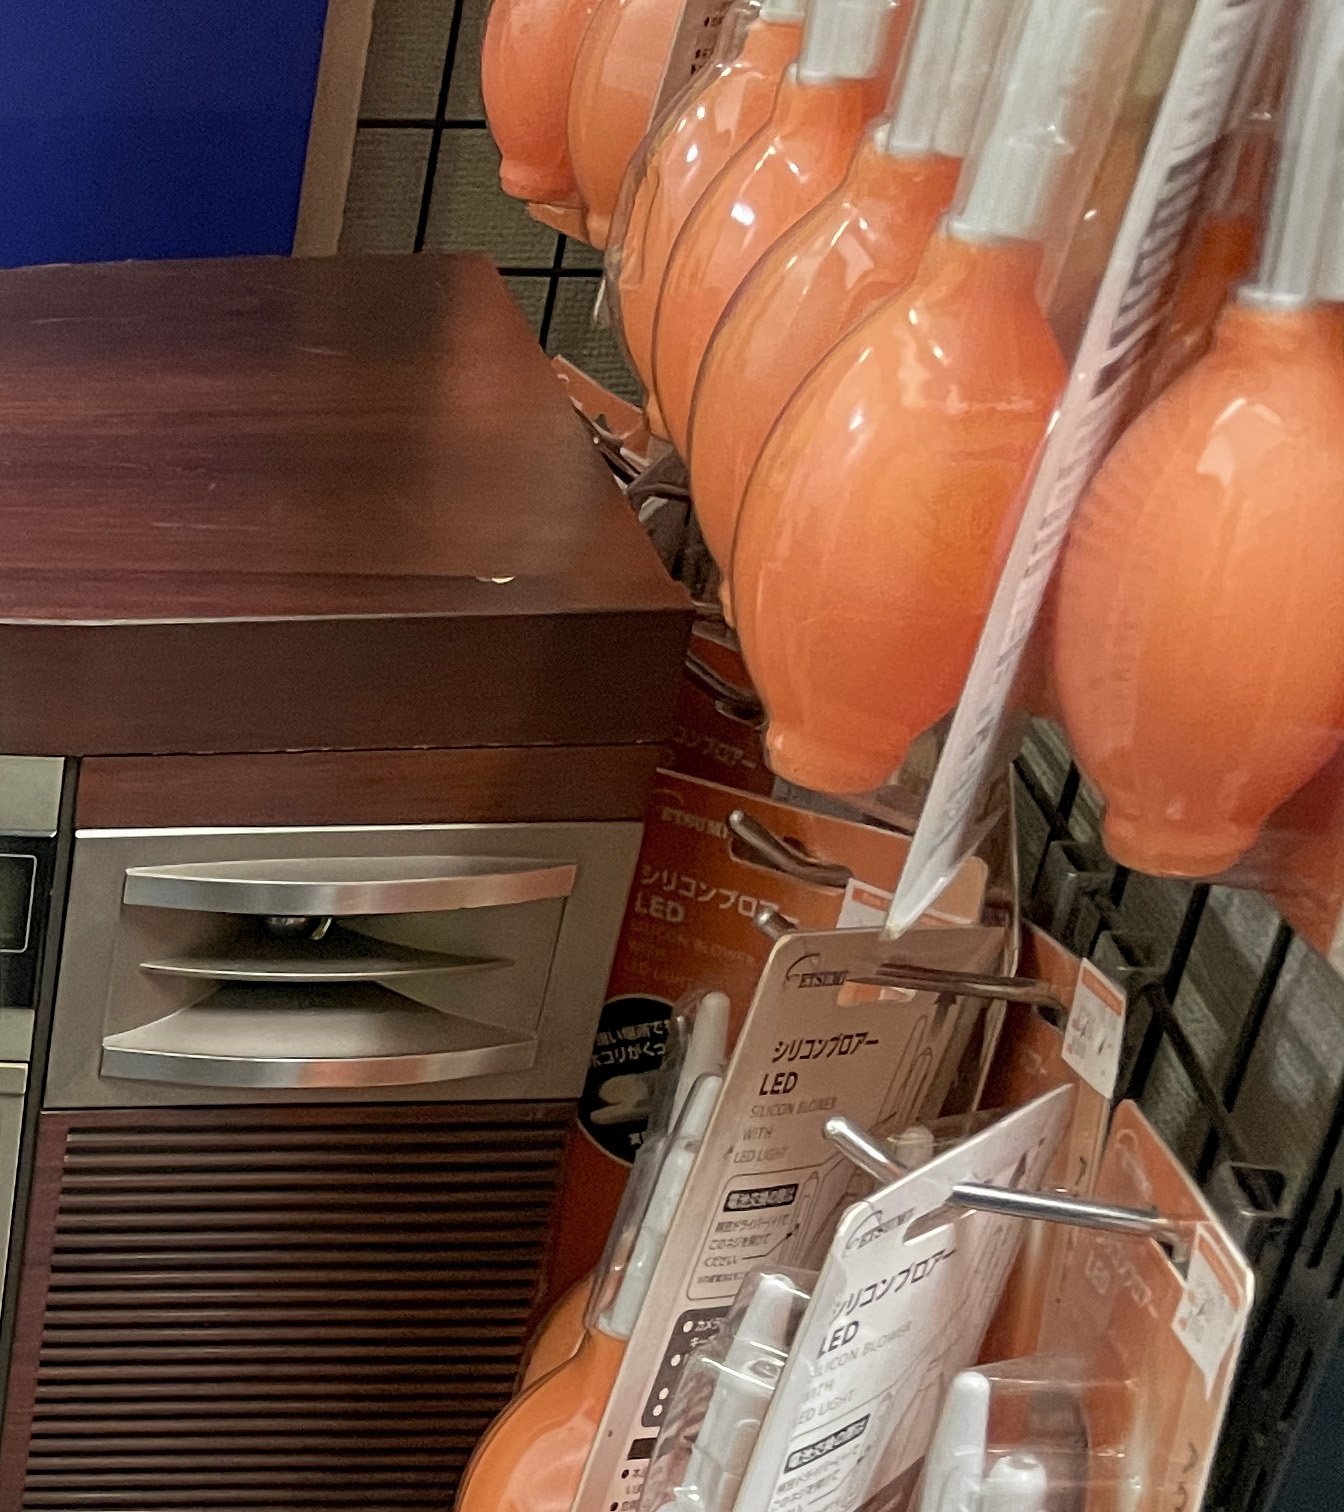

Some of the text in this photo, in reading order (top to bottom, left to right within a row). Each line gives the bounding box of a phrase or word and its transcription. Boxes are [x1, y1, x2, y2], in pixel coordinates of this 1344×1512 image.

[635, 890, 684, 923] LED
[758, 1071, 799, 1097] LED
[817, 1320, 860, 1360] LED
